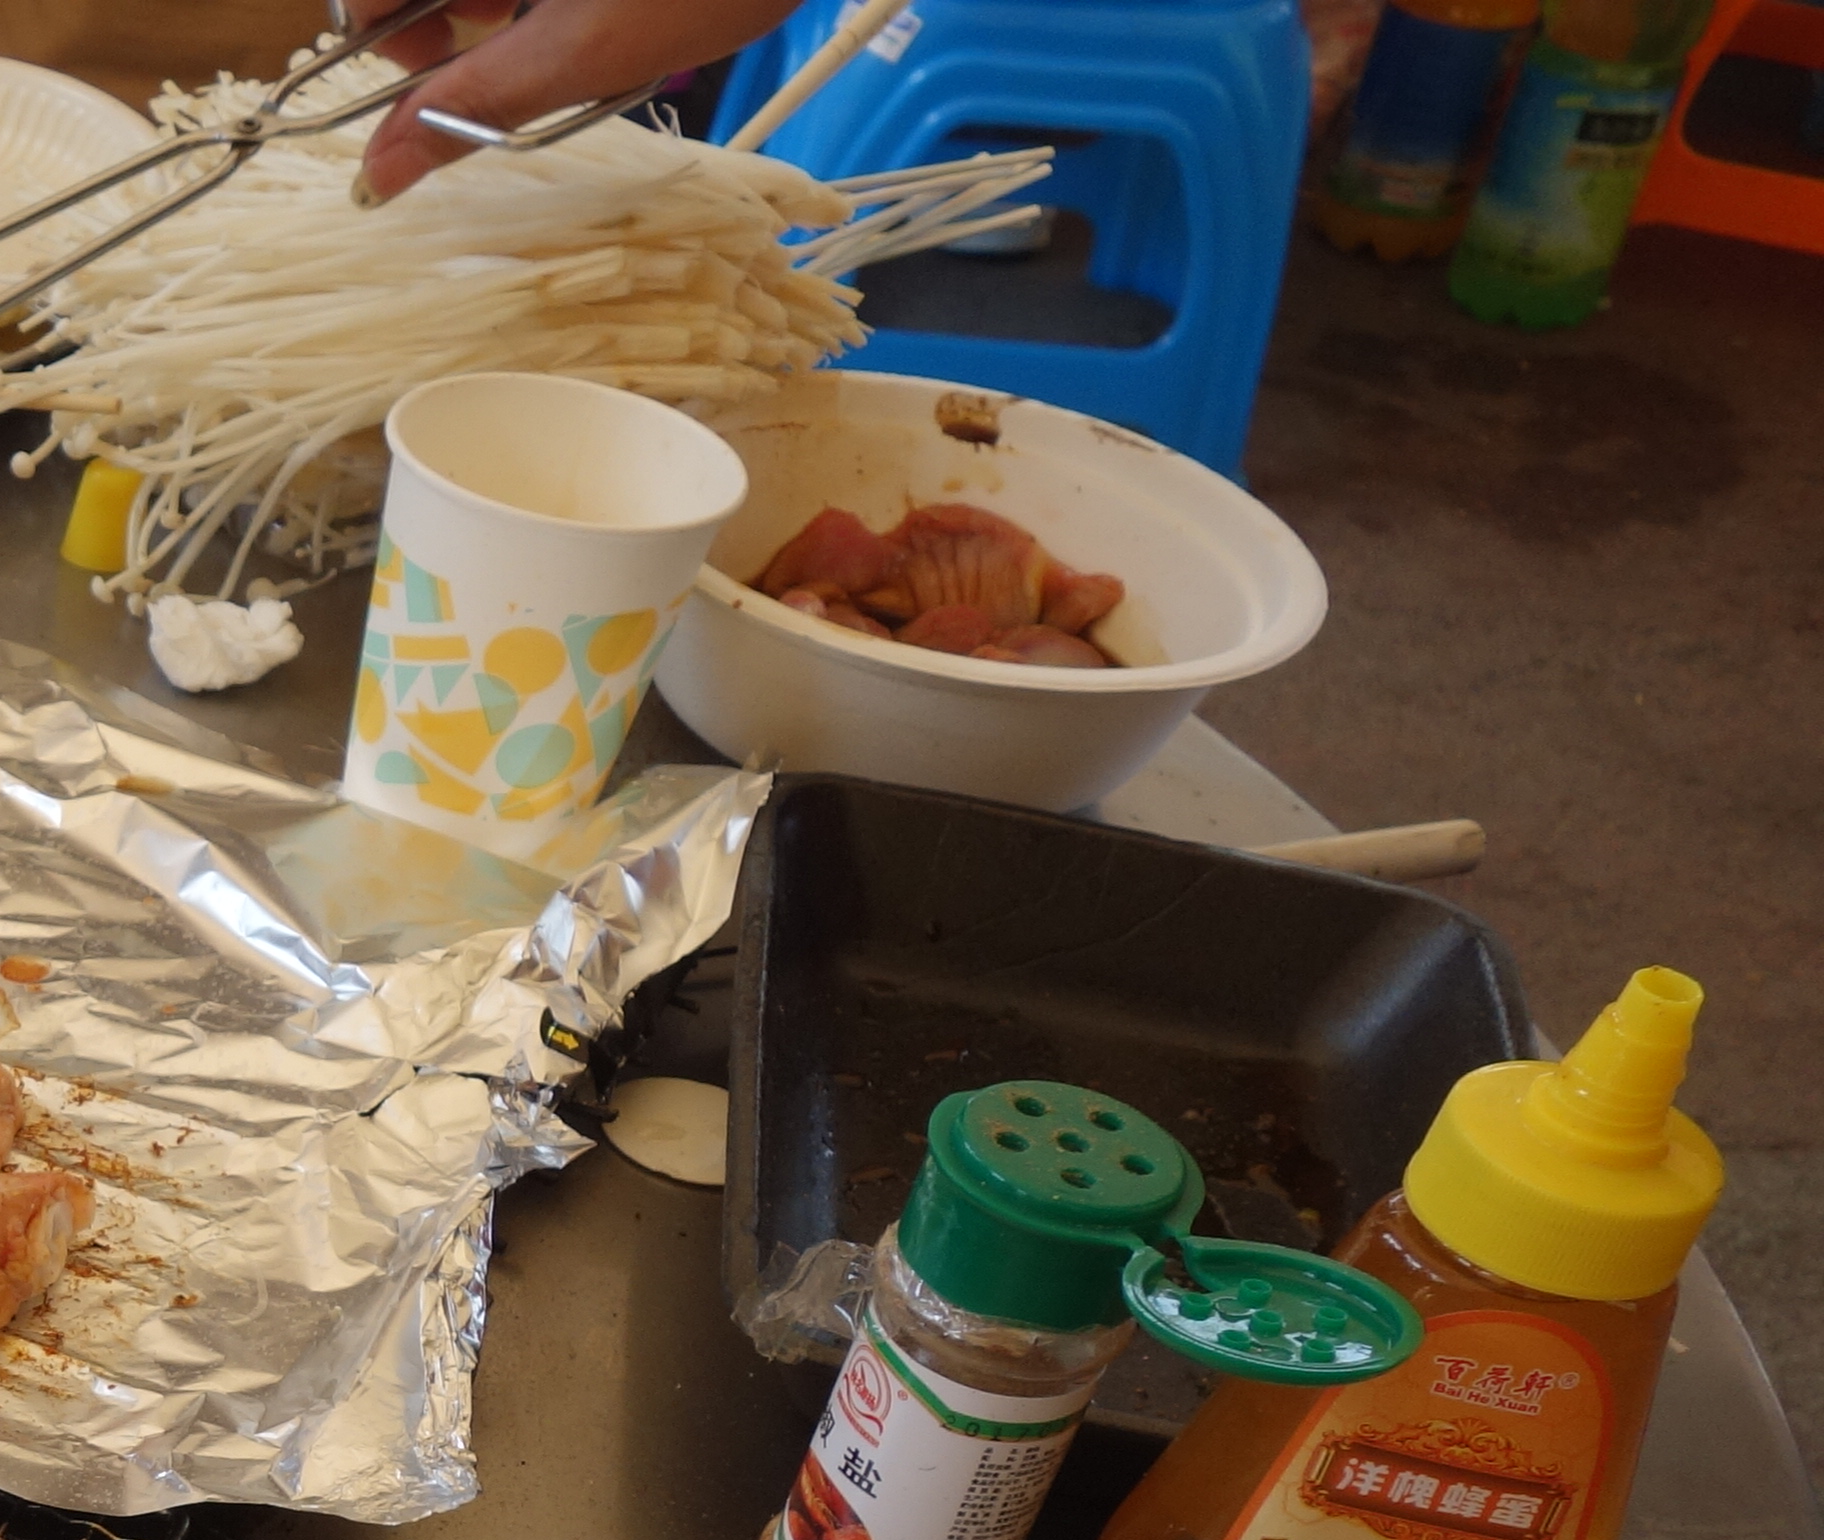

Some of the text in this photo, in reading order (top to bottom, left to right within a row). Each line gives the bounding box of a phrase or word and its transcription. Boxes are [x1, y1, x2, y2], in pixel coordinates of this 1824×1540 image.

[1433, 1382, 1541, 1415] Bai He Xuan
[1435, 1355, 1554, 1399] 百荷轩
[1336, 1457, 1544, 1530] 洋槐蜂蜜
